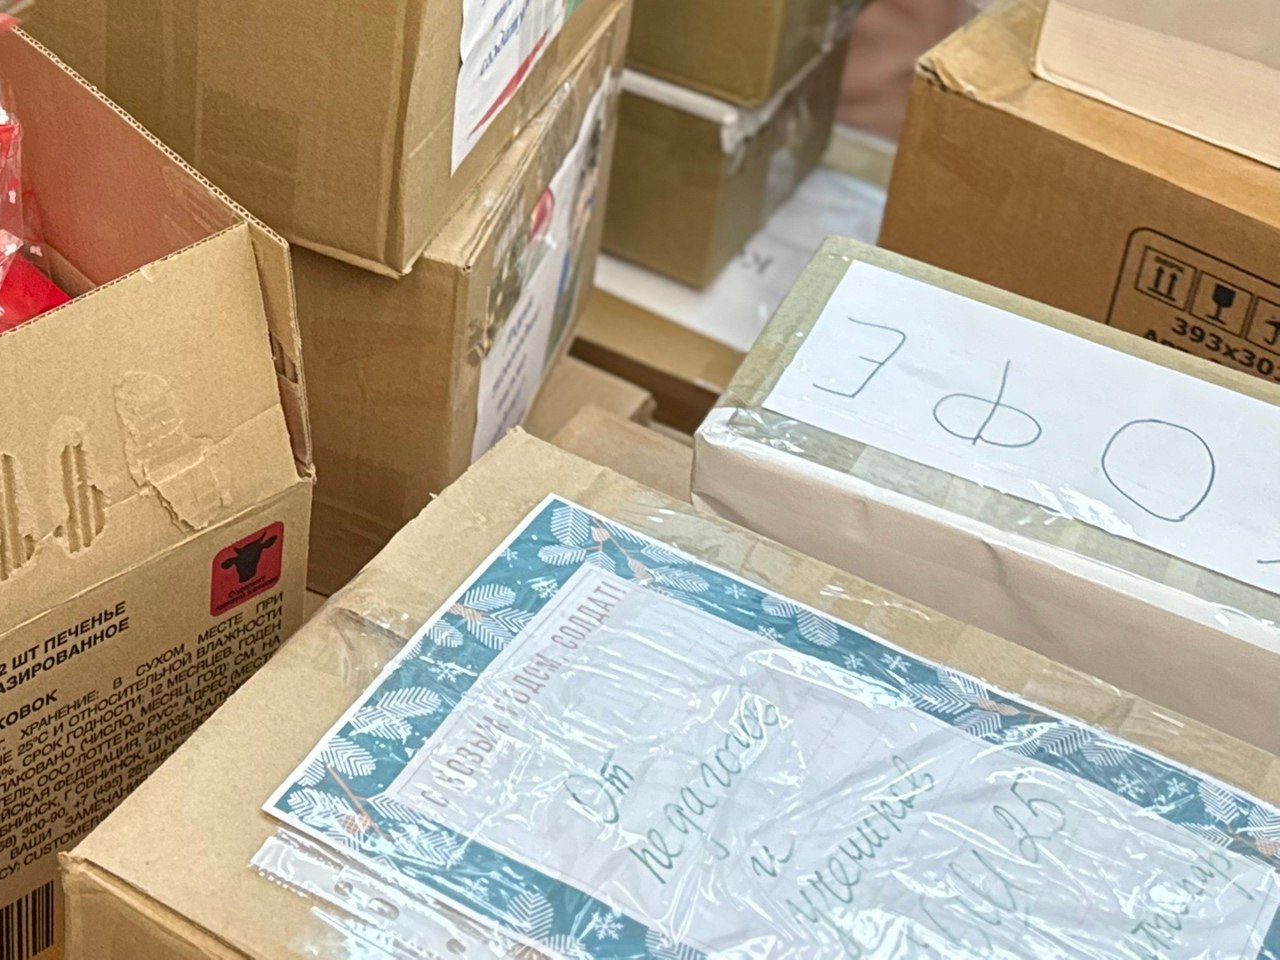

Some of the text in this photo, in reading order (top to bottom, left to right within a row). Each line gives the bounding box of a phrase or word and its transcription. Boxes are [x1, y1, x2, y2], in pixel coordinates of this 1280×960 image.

[12, 644, 39, 670] ШТ
[44, 599, 126, 654] ПЕЧЕНЬЕ
[262, 632, 280, 652] НА
[551, 580, 628, 650] СОЛДАТ!
[20, 687, 99, 740] ХРАНЕНИЕ:
[112, 675, 122, 690] В
[136, 642, 184, 678] СУХОМ
[197, 610, 243, 646] МЕСТЕ
[256, 590, 282, 615] ПРИ
[22, 736, 62, 768] СРОК
[66, 691, 144, 746] ГОДНОСТИ:
[150, 681, 162, 699] 12
[167, 643, 234, 691] МЕСЯЦЕВ.
[239, 618, 281, 652] ГОДЕН
[53, 721, 62, 737] И
[68, 650, 191, 729] ОТНОСИТЕЛЬНОЙ
[196, 604, 282, 660] ВЛАЖНОСТИ
[37, 761, 69, 788] ООО
[125, 720, 144, 739] КФ
[183, 674, 227, 708] АДРЕС
[53, 735, 140, 796] ФЕДЕРАЦИЯ,
[75, 747, 144, 795] ОБНИНСК,
[10, 826, 51, 860] ВАШИ
